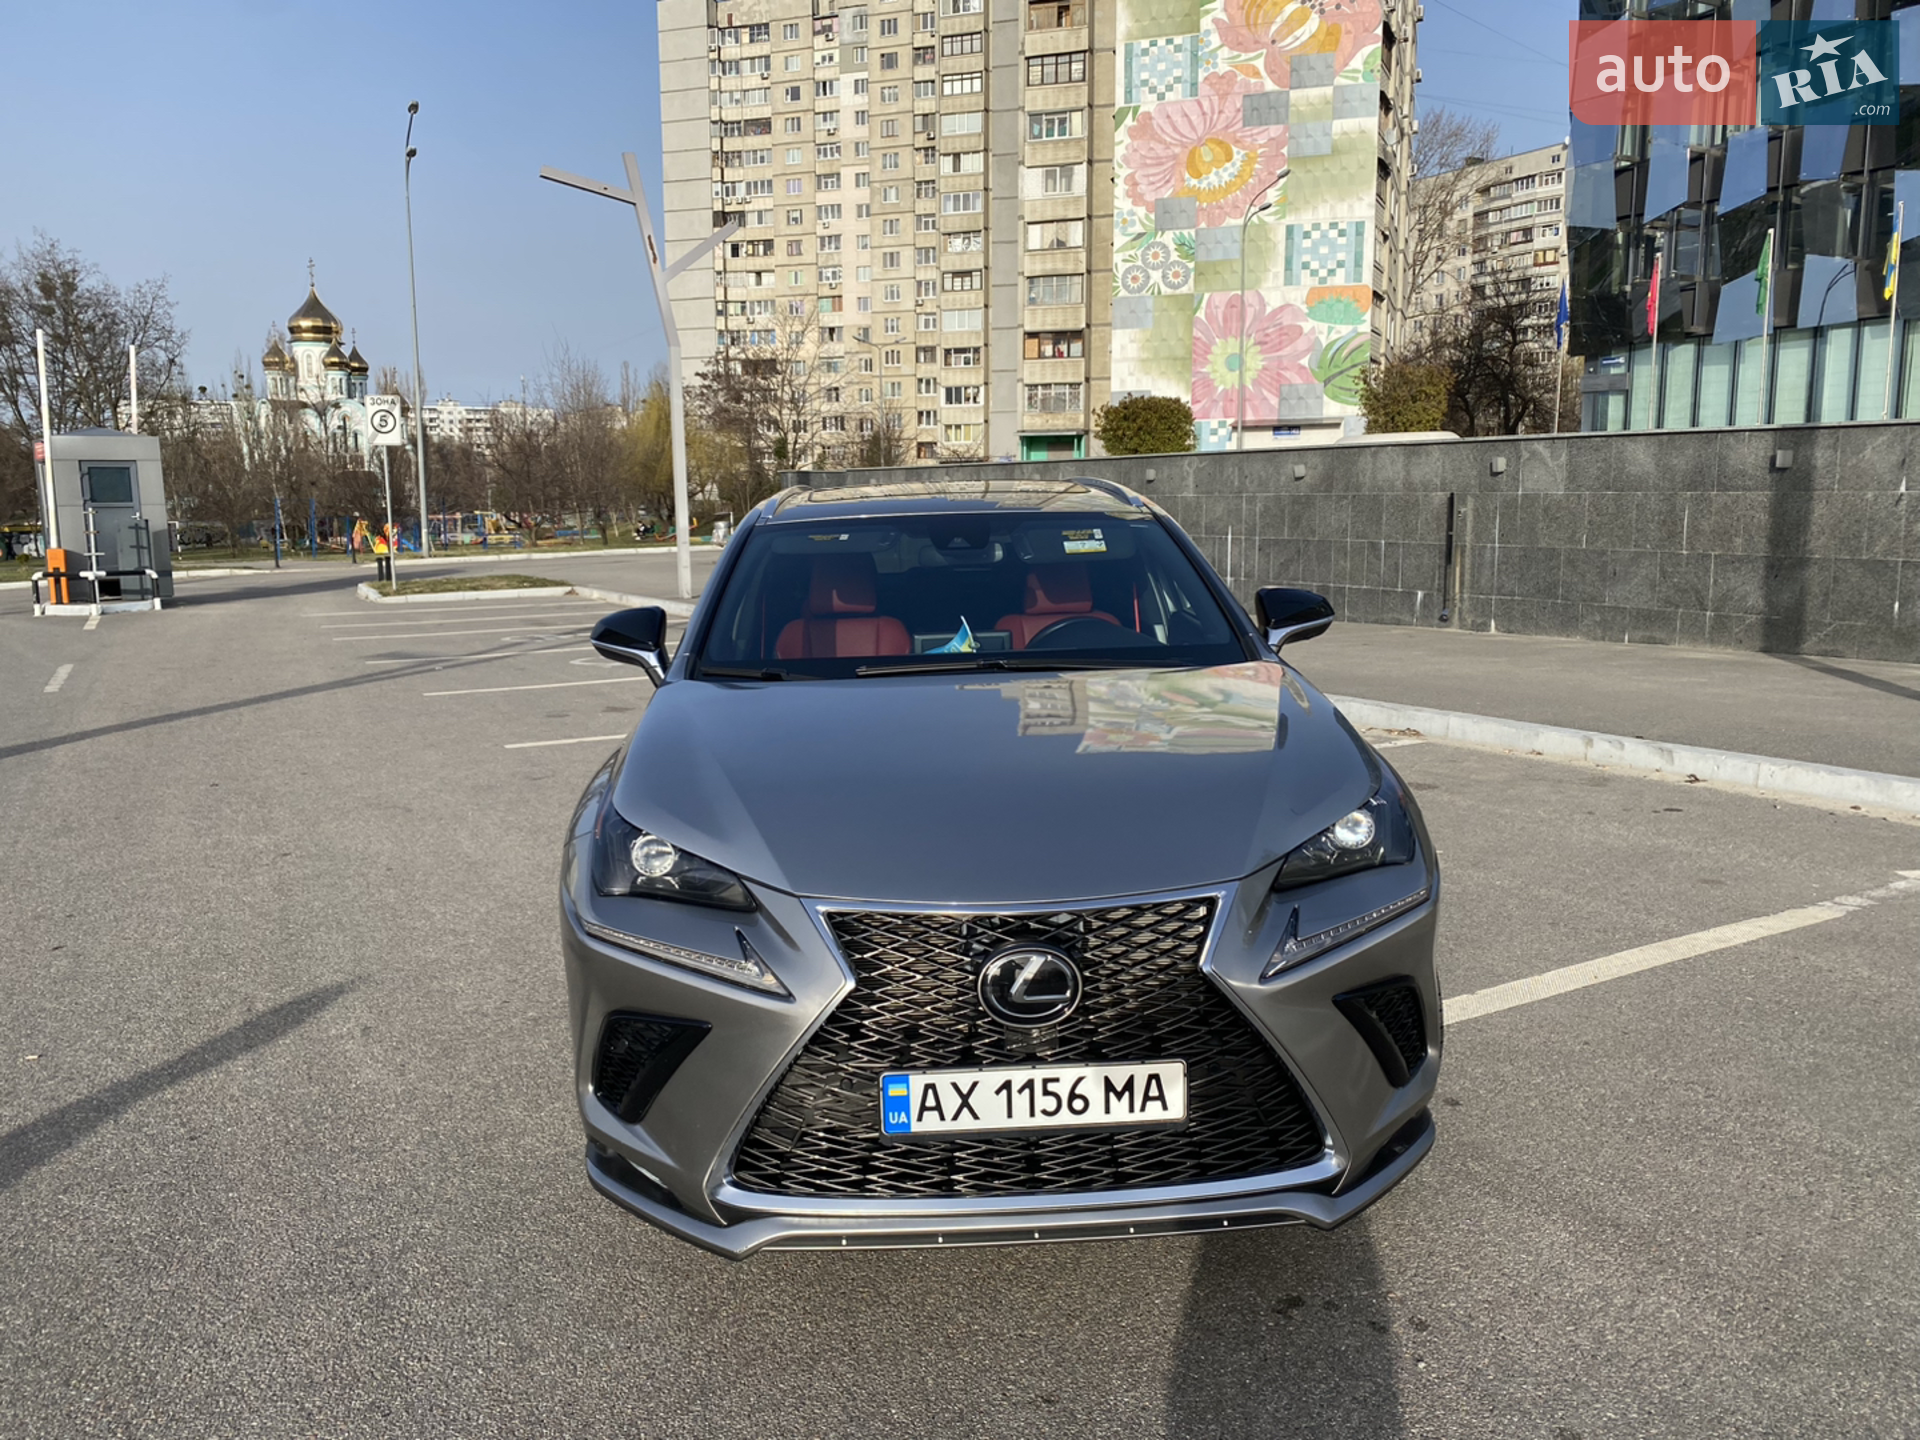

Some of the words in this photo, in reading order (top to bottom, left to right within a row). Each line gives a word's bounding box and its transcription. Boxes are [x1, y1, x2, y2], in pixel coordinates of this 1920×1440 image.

[369, 396, 397, 406] ЗОНА
[379, 414, 389, 428] 5
[916, 1081, 981, 1122] AX
[994, 1076, 1090, 1119] 1156
[1104, 1073, 1169, 1115] MA
[889, 1111, 909, 1125] UA
